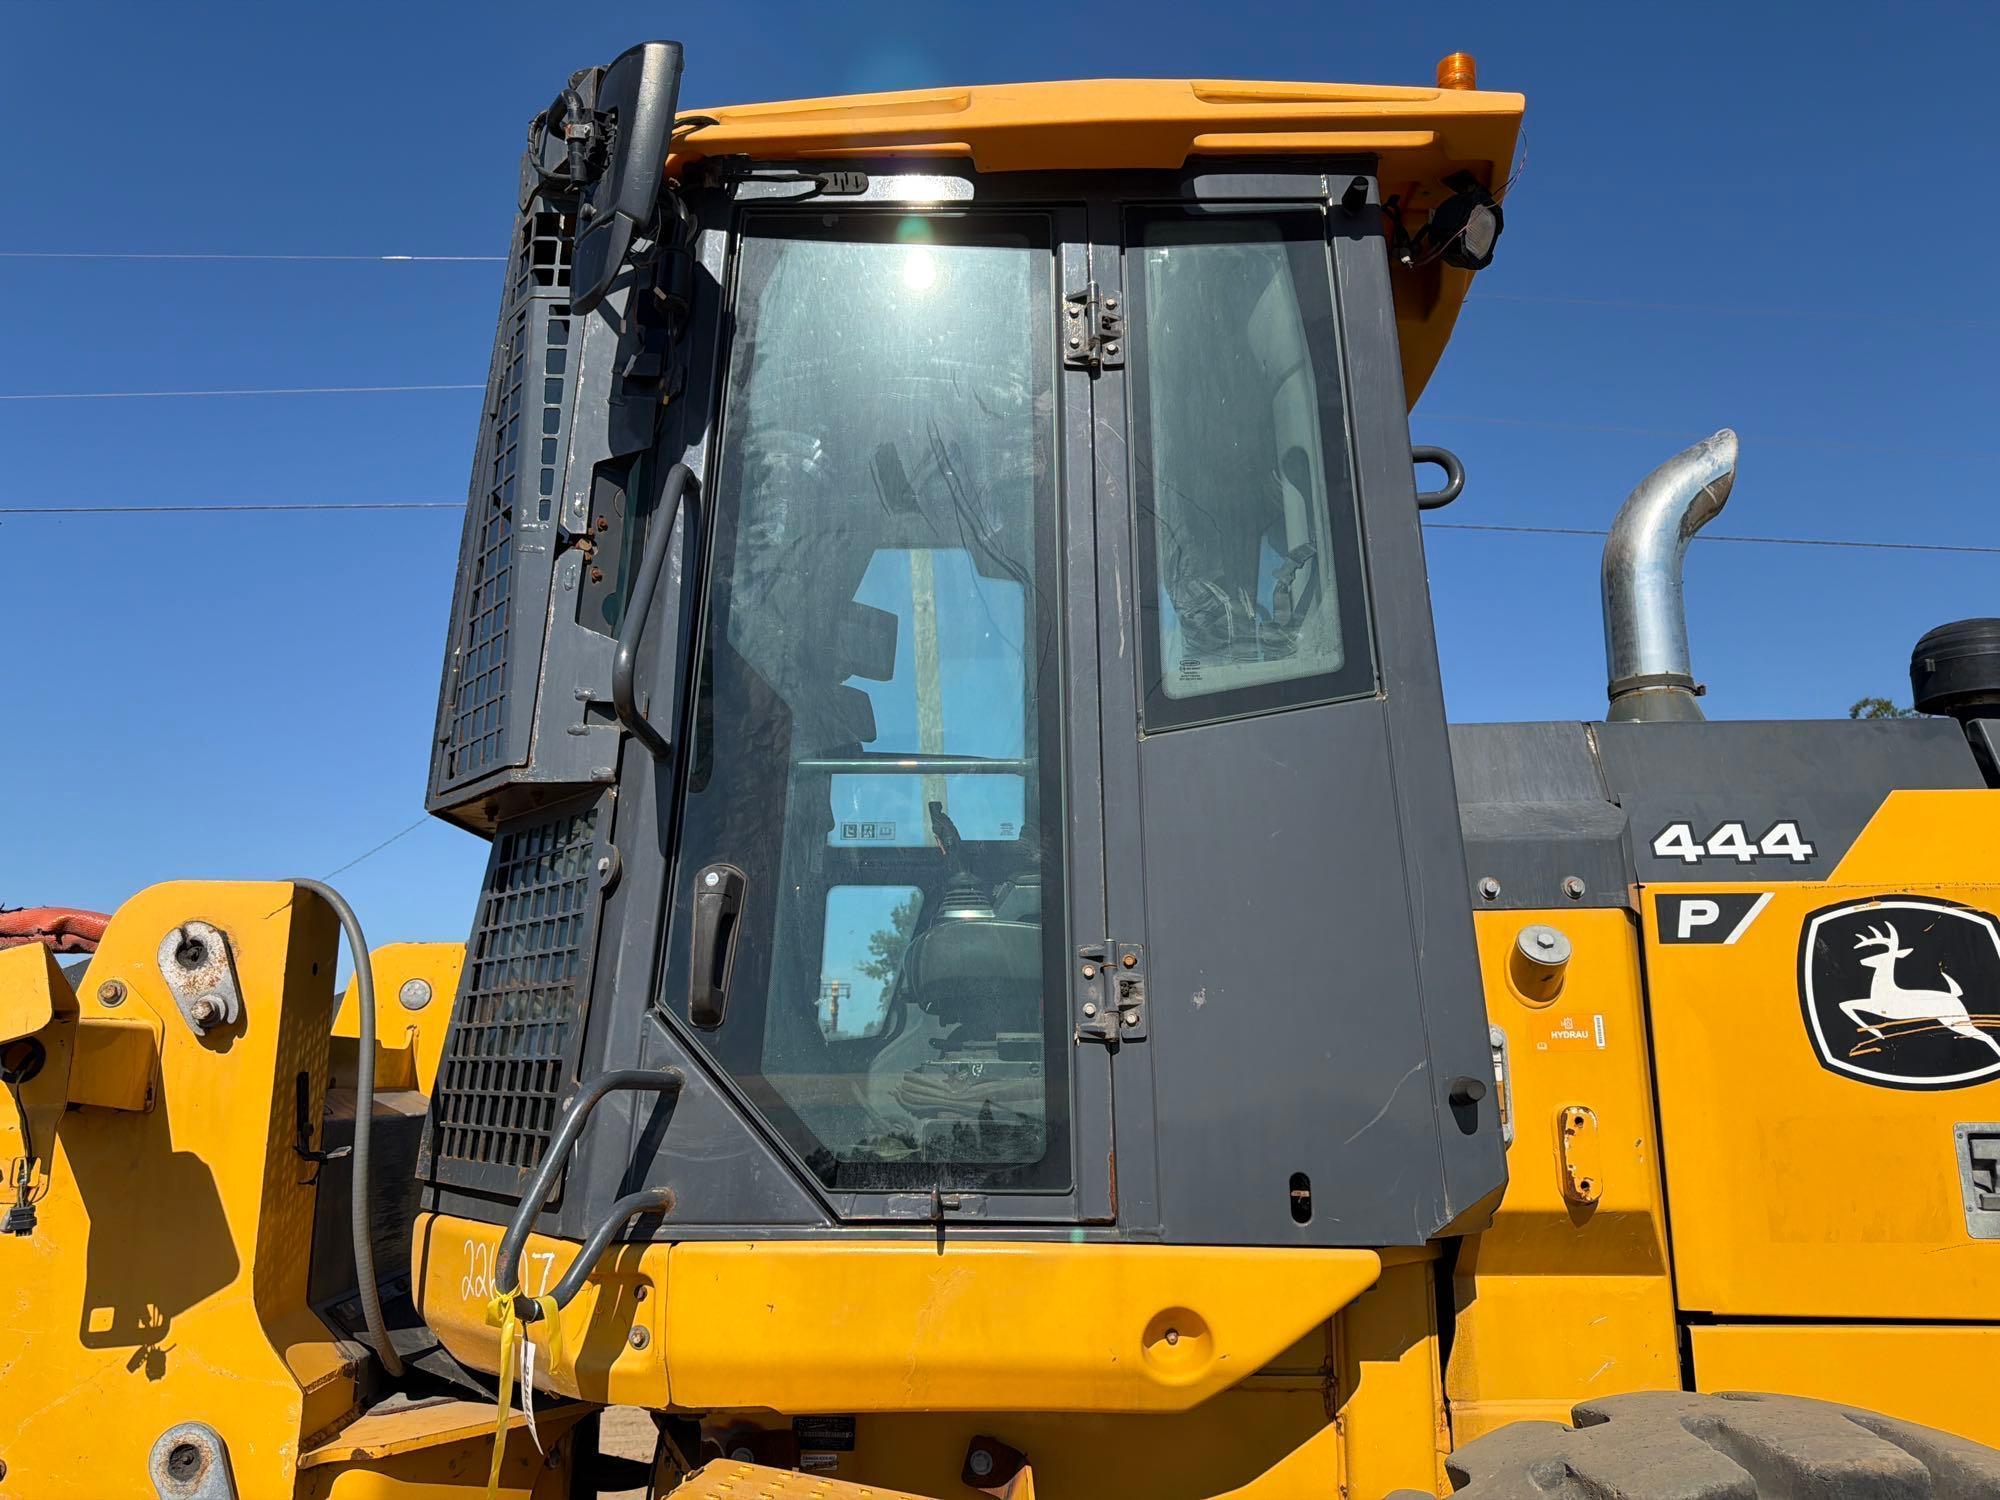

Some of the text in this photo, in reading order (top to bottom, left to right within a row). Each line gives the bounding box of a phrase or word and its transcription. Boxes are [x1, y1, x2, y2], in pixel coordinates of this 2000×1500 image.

[1652, 822, 1814, 862] 444
[1677, 899, 1720, 939] P
[1550, 1030, 1590, 1040] HYDRAU
